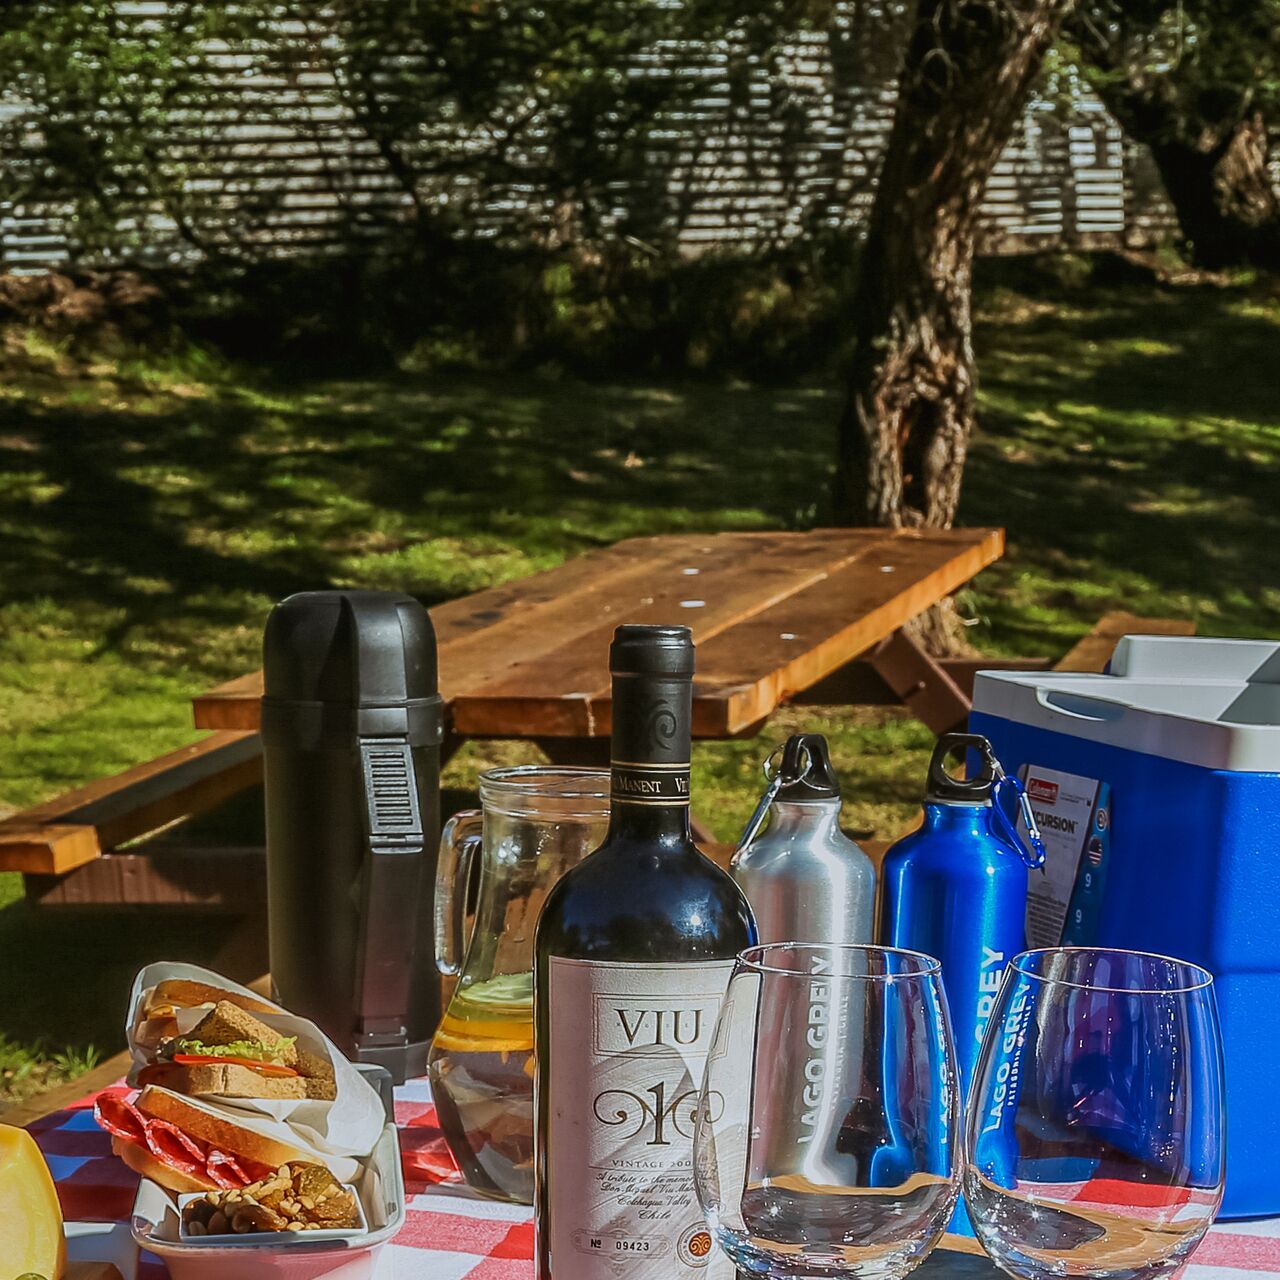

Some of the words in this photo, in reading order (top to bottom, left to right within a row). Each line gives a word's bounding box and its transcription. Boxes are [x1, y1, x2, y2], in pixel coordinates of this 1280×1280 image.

[619, 776, 661, 793] MANENT
[1032, 811, 1075, 834] CURSION
[1085, 873, 1091, 887] 9
[1075, 909, 1081, 923] 9
[613, 1009, 702, 1046] VIU
[982, 1061, 1011, 1134] LAGO
[1003, 983, 1031, 1054] GREY
[612, 1159, 664, 1169] VINTAGE
[666, 1175, 694, 1183] memor
[665, 1194, 692, 1208] Valley
[638, 1209, 672, 1220] Chile
[615, 1241, 650, 1252] 09423
